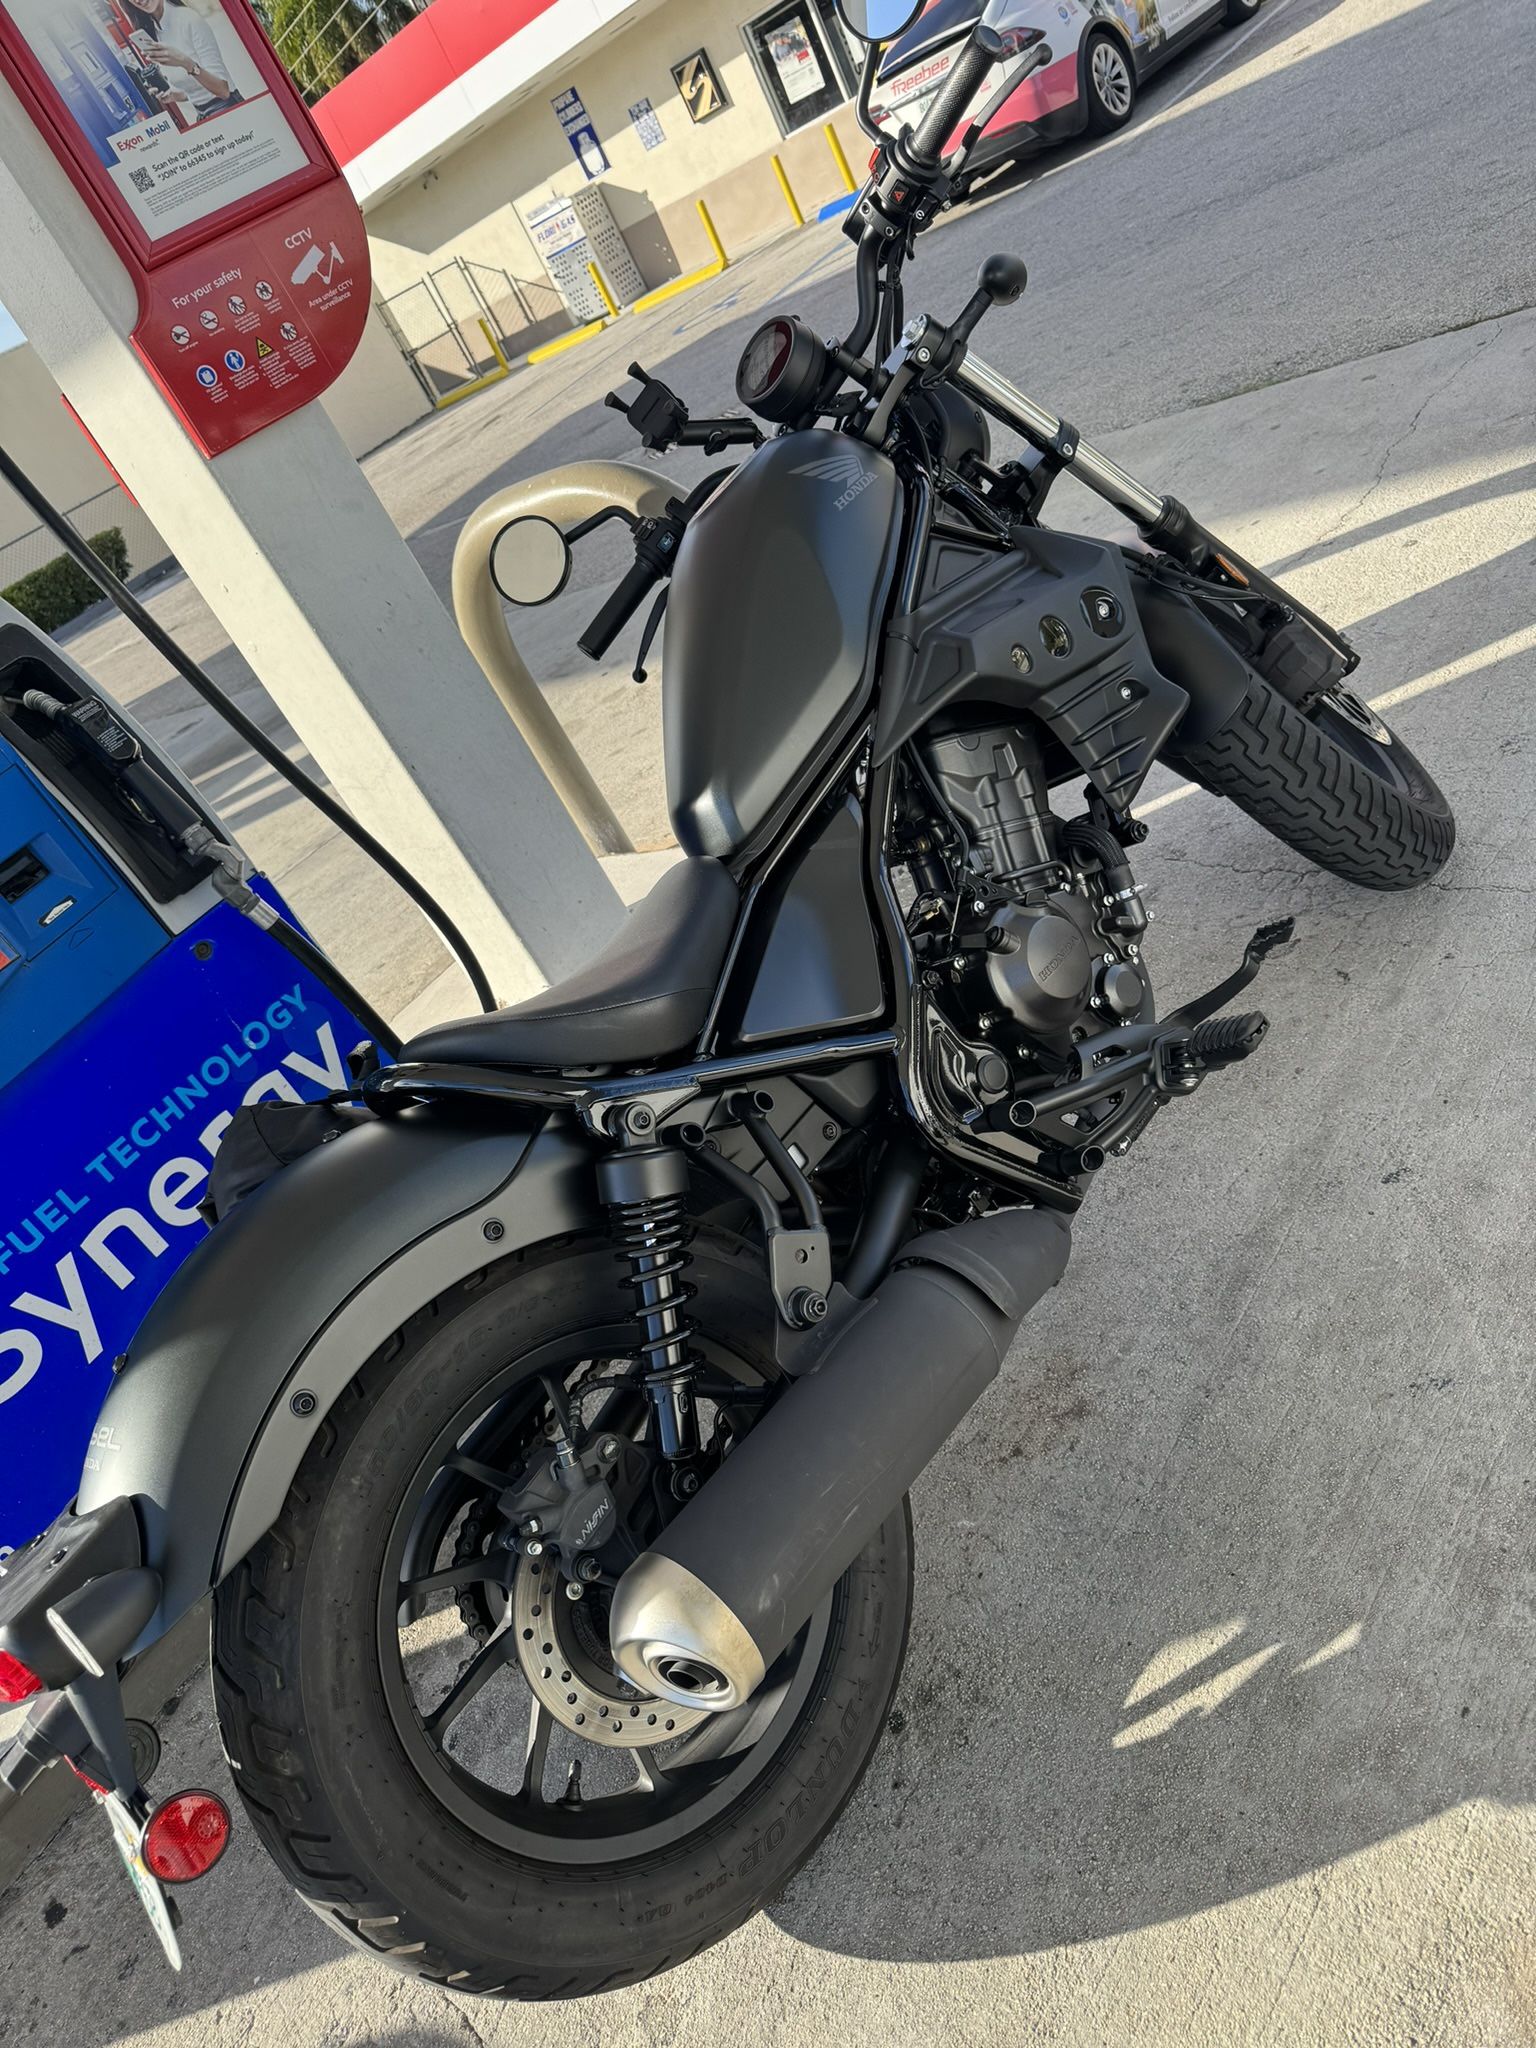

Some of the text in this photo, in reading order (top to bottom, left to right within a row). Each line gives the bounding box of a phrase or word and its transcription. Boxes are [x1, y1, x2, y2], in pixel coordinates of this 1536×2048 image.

[891, 56, 950, 97] freebee
[116, 120, 171, 151] Exxon Mobil
[152, 134, 225, 172] Scan the QR code or text
[179, 164, 187, 172] to
[187, 153, 207, 168] 66345
[214, 145, 227, 155] sign
[226, 142, 236, 150] up
[284, 226, 313, 249] CCTV
[171, 267, 242, 309] For your safety
[308, 278, 353, 308] Area under CCTV
[320, 291, 352, 311] surveillance
[833, 471, 879, 511] HONDA
[1038, 935, 1080, 982] HONDA
[0, 984, 309, 1275] FUEL TECHNOLOGY
[739, 1705, 860, 1878] DUNLOP
